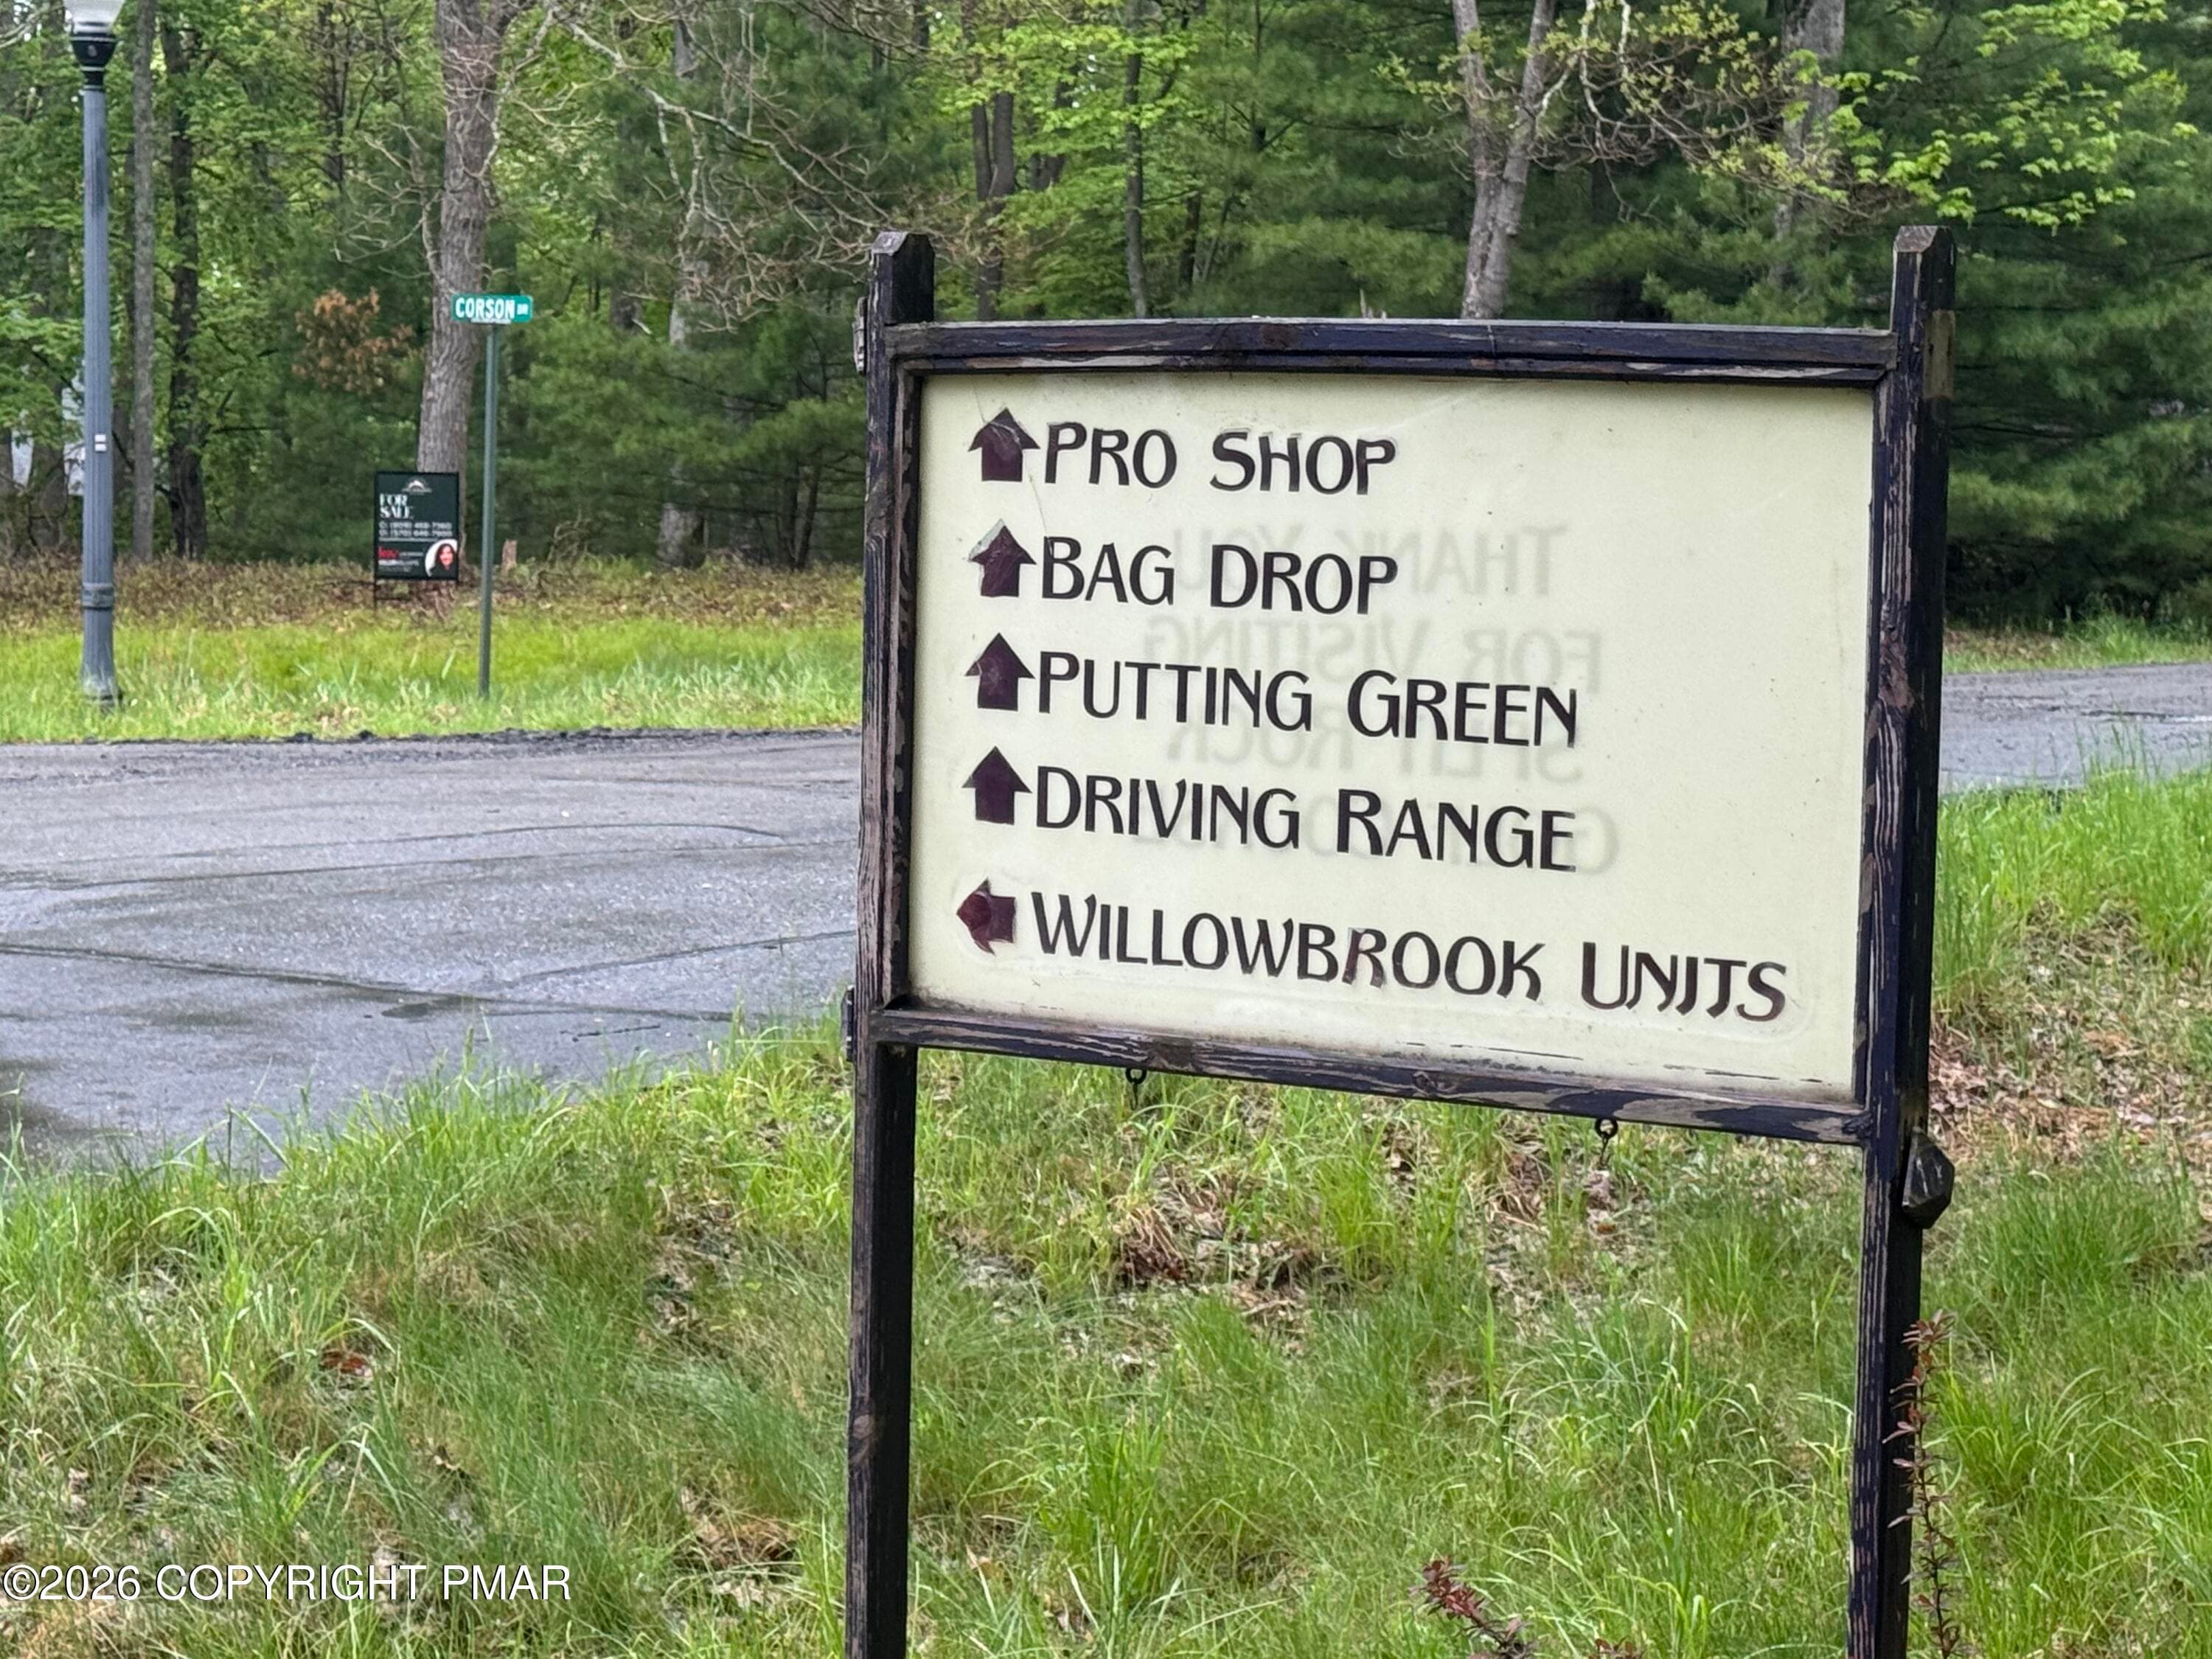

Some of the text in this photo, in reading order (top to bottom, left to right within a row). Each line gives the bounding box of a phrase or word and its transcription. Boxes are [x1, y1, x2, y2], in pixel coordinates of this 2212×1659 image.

[455, 297, 515, 319] CORSON
[1046, 422, 1395, 494] PRO SHOP
[379, 493, 408, 507] FOR
[1043, 537, 1397, 613] BAG DROP
[1040, 652, 1576, 747] PUTTING GREEN
[1037, 767, 1299, 848] DRIVING
[1338, 789, 1573, 871] RANGE
[1032, 892, 1785, 1021] WILLOWBROOK UNITS
